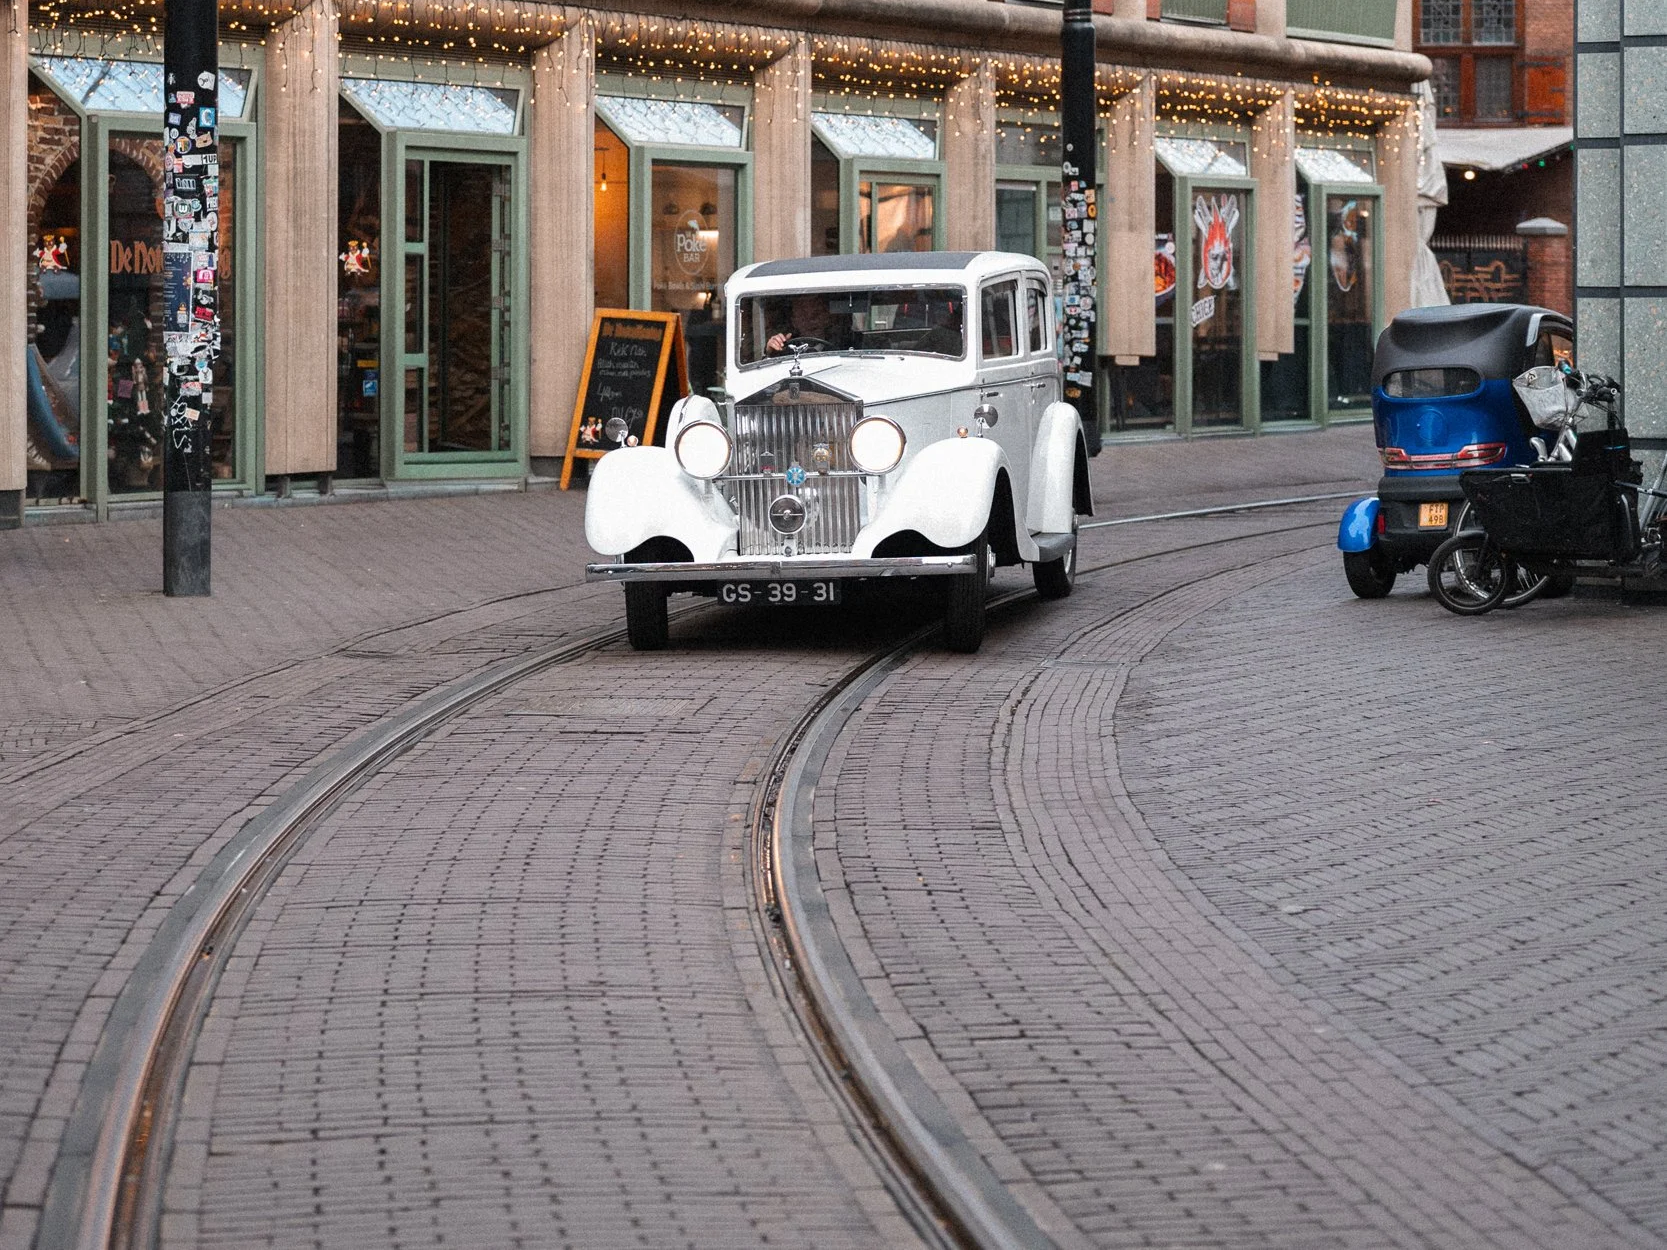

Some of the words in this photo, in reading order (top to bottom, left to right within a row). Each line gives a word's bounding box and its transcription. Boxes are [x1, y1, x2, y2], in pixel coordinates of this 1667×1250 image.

[110, 240, 133, 274] De
[683, 253, 700, 263] BAR
[1429, 504, 1444, 513] FTP
